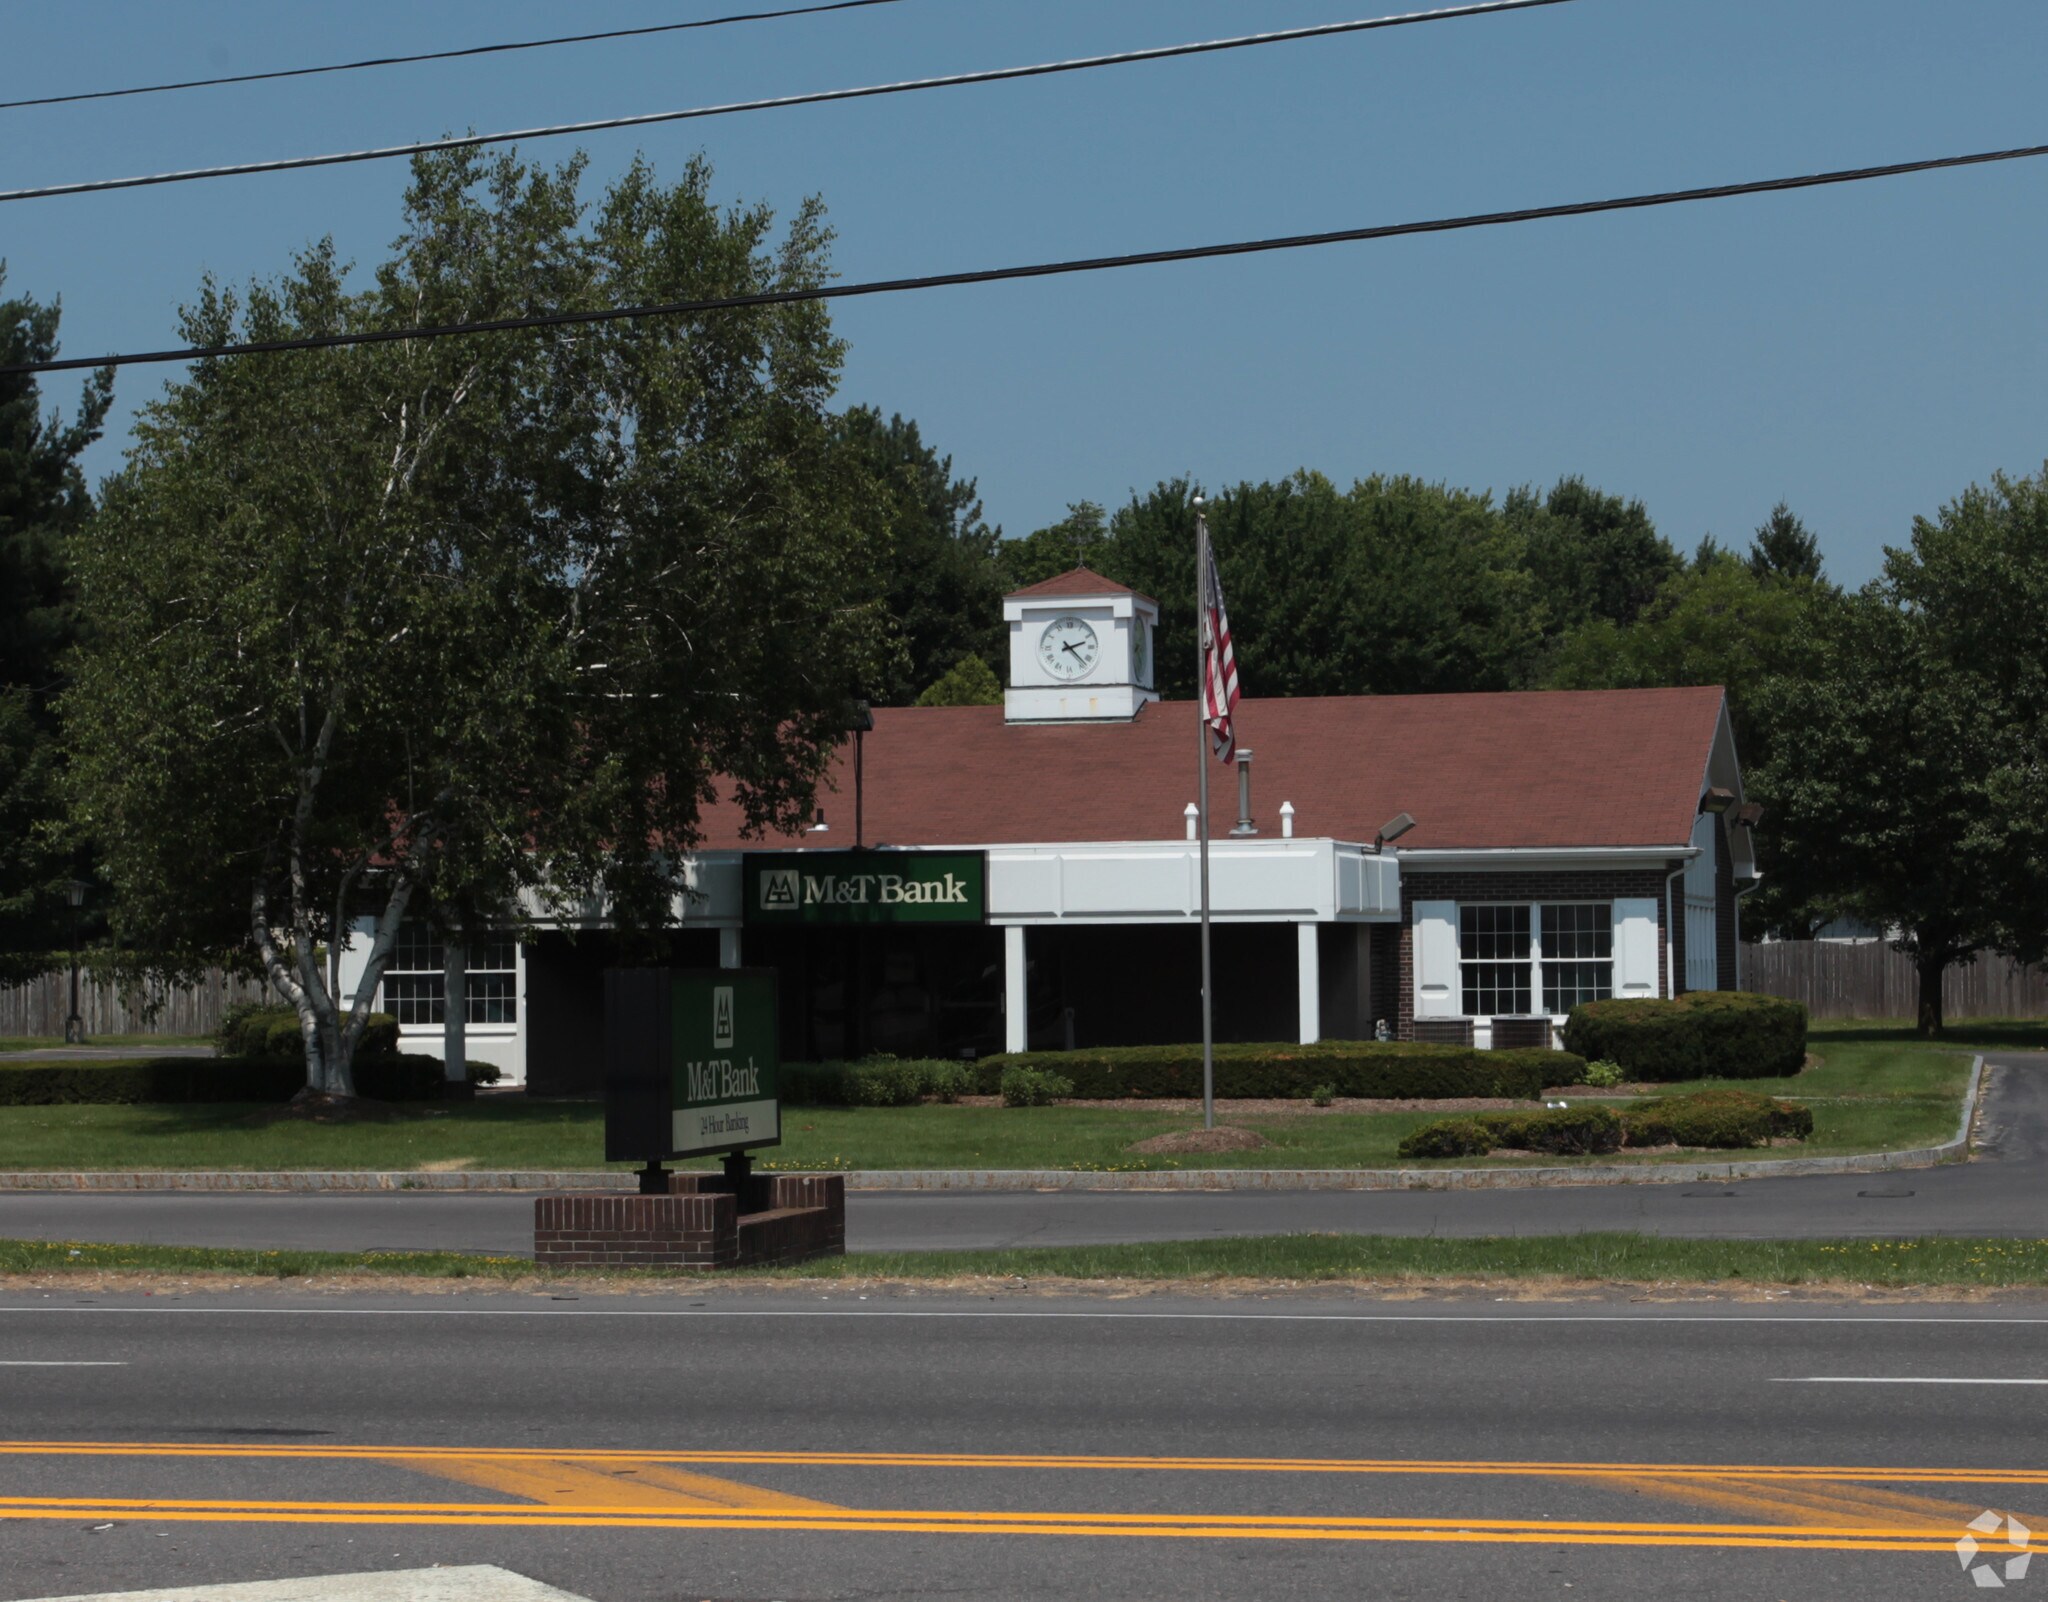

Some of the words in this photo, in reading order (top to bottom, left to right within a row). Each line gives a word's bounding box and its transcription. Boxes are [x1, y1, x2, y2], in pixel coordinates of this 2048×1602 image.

[803, 874, 876, 904] M&T
[878, 872, 969, 904] Bank
[687, 1059, 720, 1102] M&T
[721, 1056, 760, 1099] Bank
[708, 1115, 724, 1135] Hour
[725, 1111, 750, 1135] Banking
